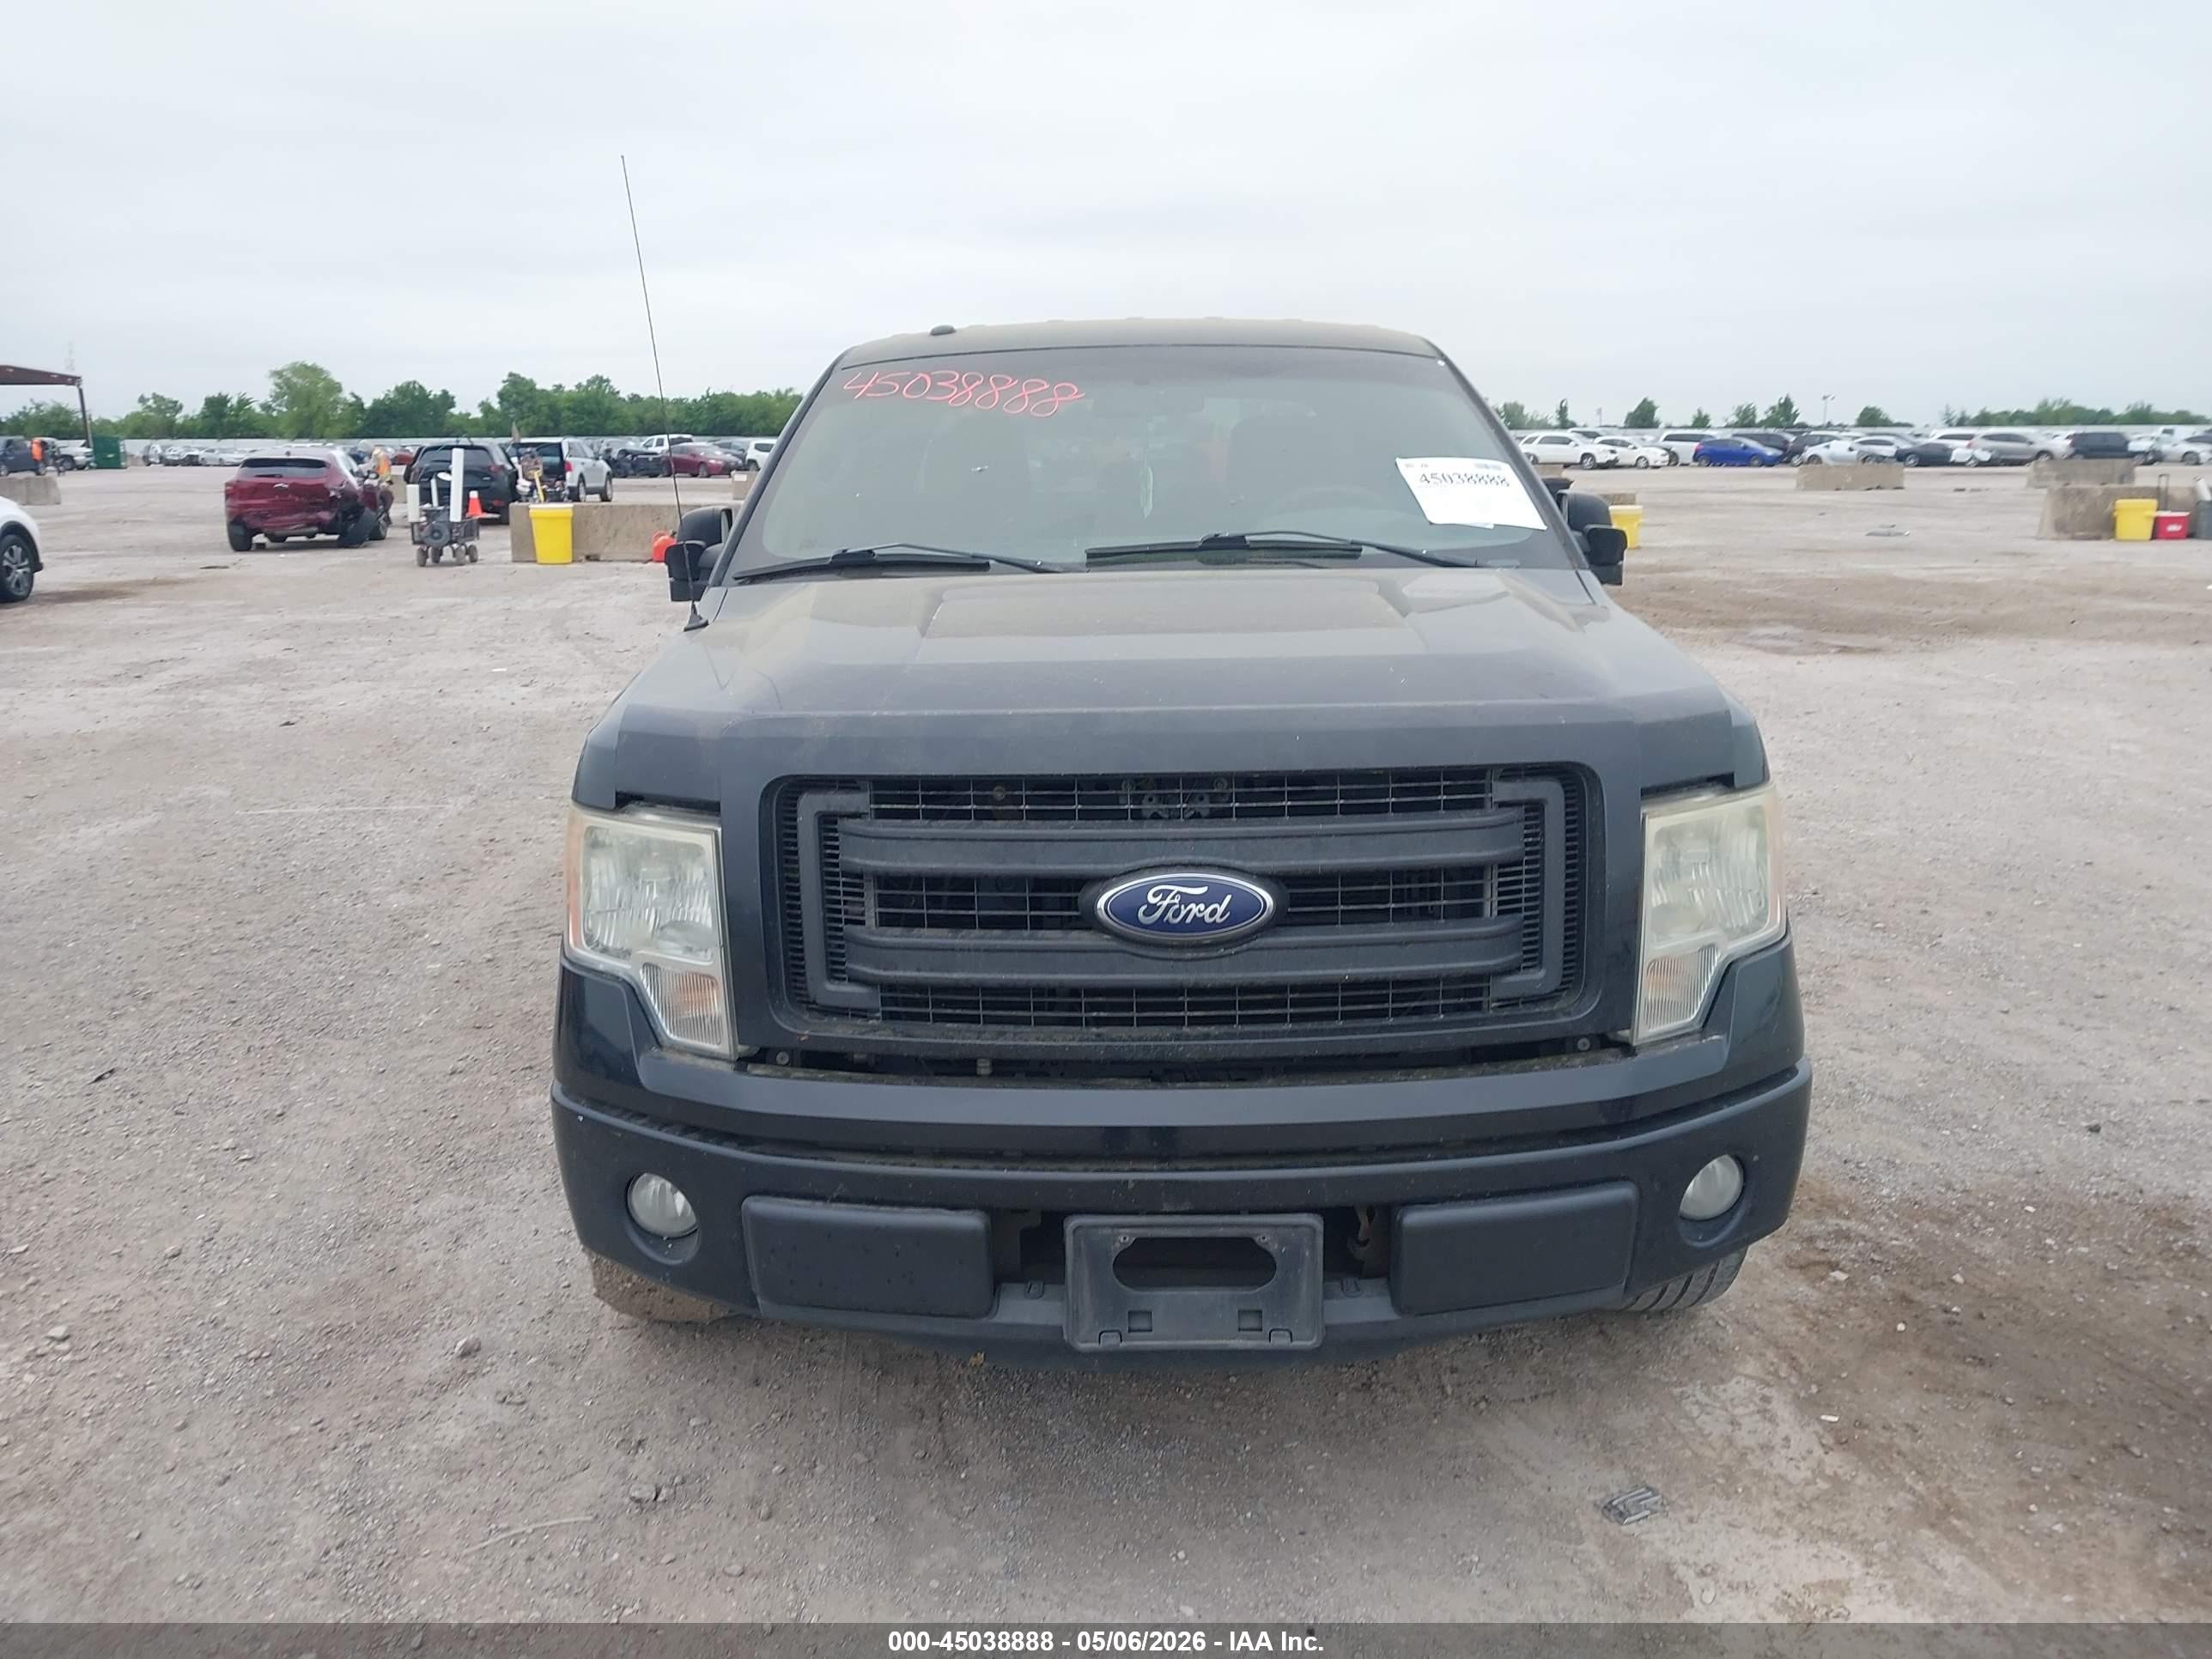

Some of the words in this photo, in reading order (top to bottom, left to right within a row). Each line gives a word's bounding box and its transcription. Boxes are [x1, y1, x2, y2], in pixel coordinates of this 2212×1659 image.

[842, 370, 1085, 417] 45038888
[1419, 472, 1510, 487] 45038888
[1138, 885, 1232, 925] Ford
